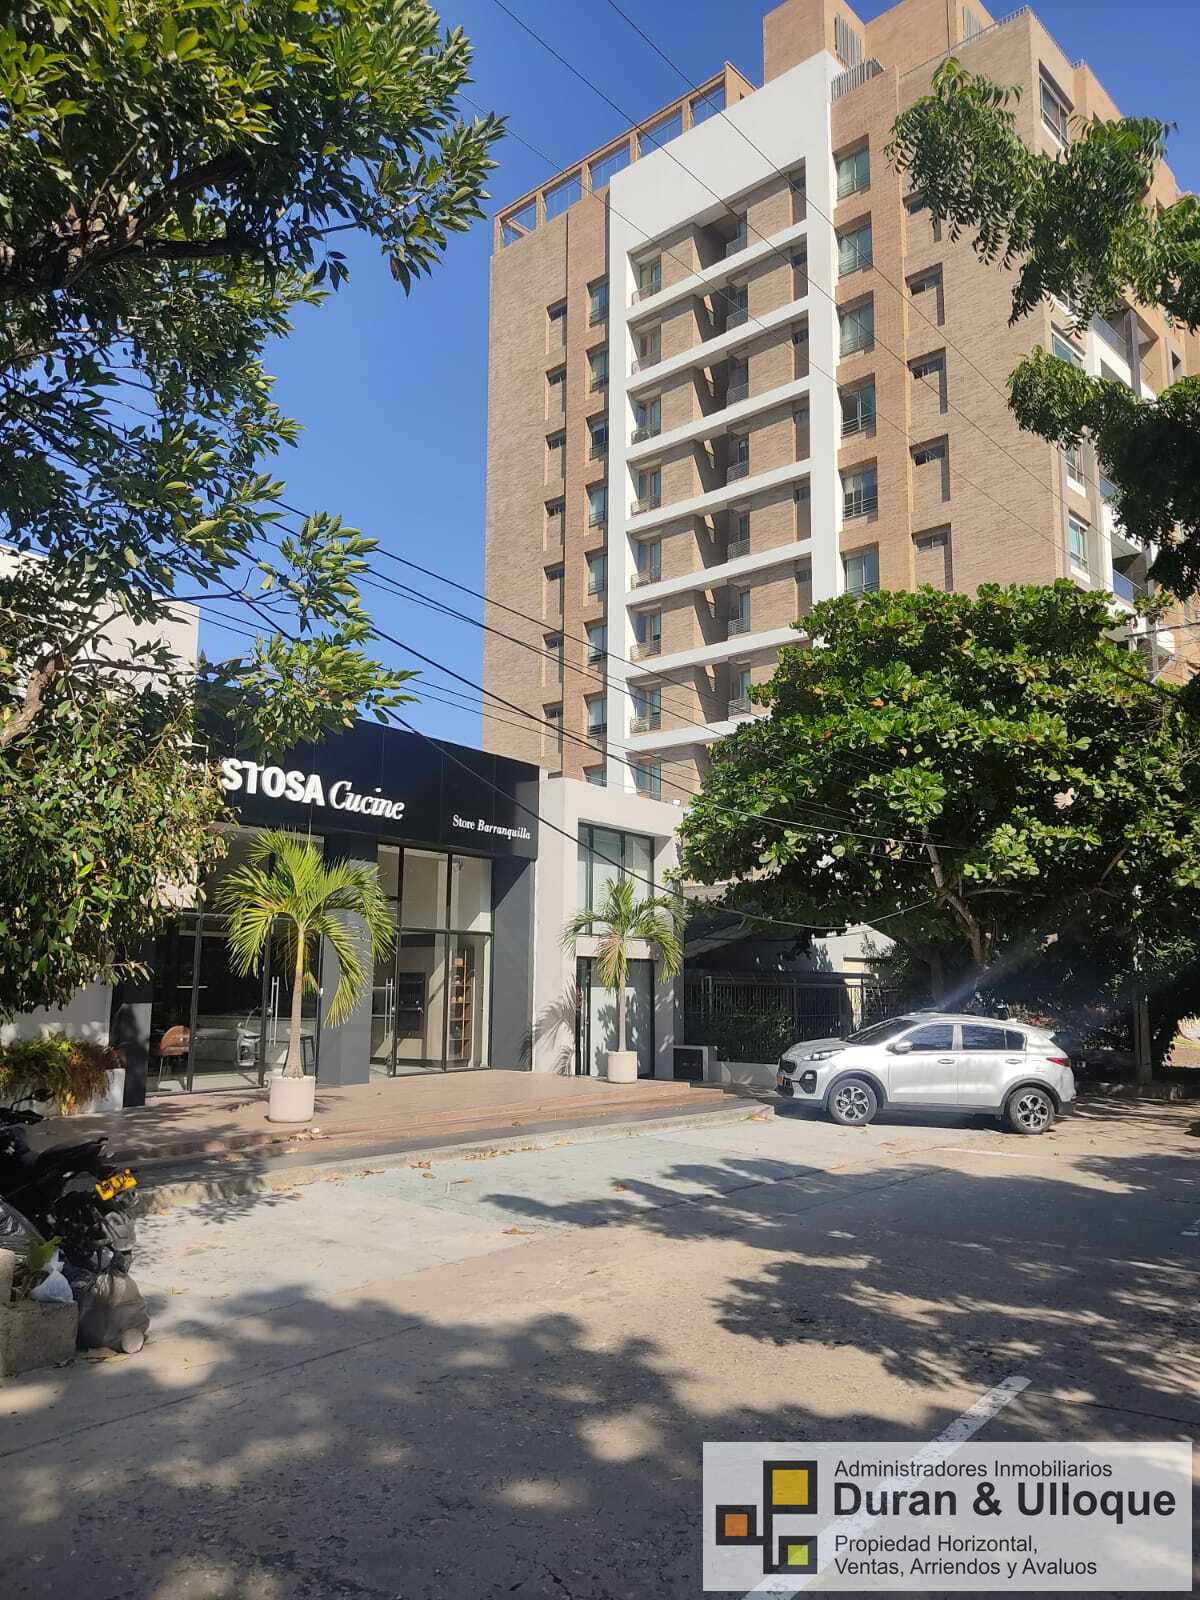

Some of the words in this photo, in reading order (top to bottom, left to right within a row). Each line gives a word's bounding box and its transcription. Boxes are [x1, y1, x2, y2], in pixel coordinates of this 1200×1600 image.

[221, 758, 326, 807] STOSA
[329, 780, 406, 820] Cucine
[452, 814, 476, 830] Store
[477, 819, 531, 840] Barranquilla
